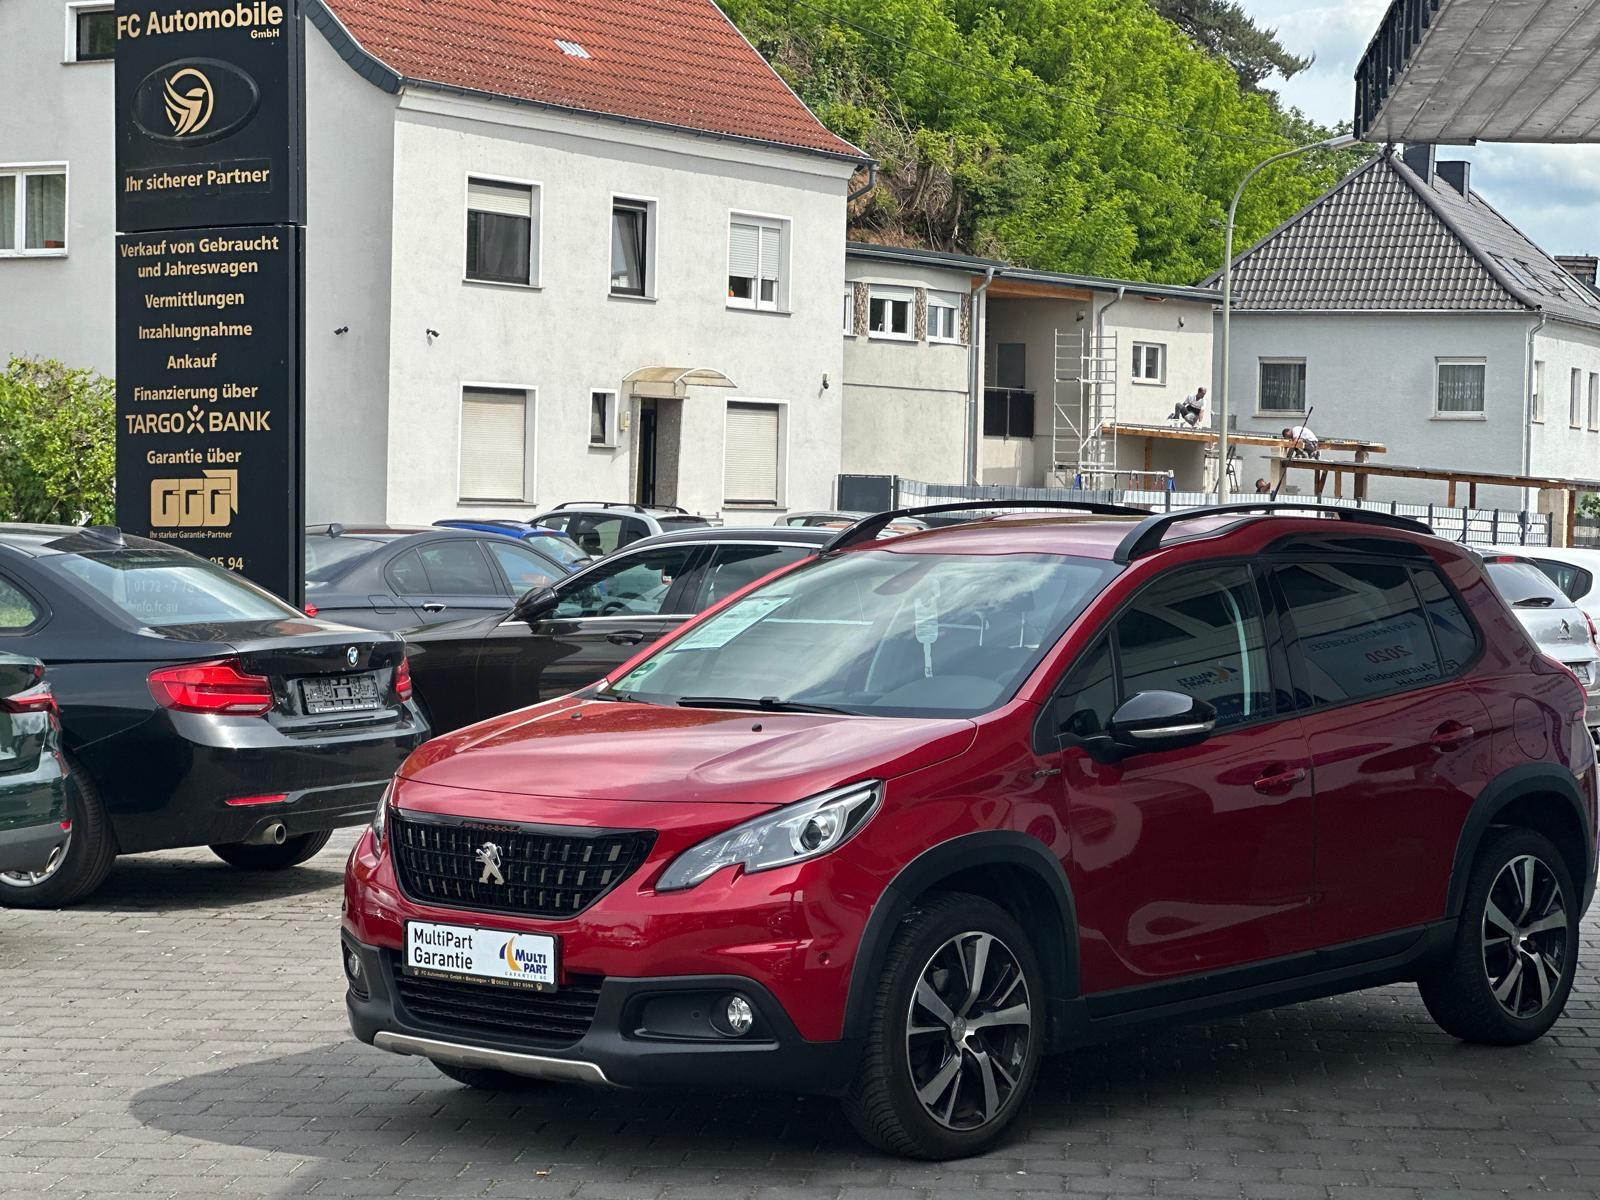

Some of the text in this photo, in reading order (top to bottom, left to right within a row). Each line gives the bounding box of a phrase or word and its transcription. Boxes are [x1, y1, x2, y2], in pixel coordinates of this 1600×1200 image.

[117, 1, 283, 40] FC Automobile
[250, 29, 280, 39] GmbH
[125, 168, 270, 192] Ihr sicherer Partner
[120, 236, 279, 257] Verkauf von Gebraucht
[138, 260, 258, 278] und Jahreswagen
[145, 291, 245, 309] Vermittlungen
[138, 322, 253, 340] Inzahlungnahme
[166, 353, 218, 370] Ankauf
[134, 384, 258, 402] Finanzierung über
[146, 448, 242, 465] Garantie über
[149, 530, 233, 540] Ihr starker Garantie-Partner
[228, 557, 244, 570] 94
[414, 928, 473, 950] MultiPart
[414, 947, 473, 970] Garantie
[515, 949, 546, 963] MULTI
[523, 963, 547, 975] PART
